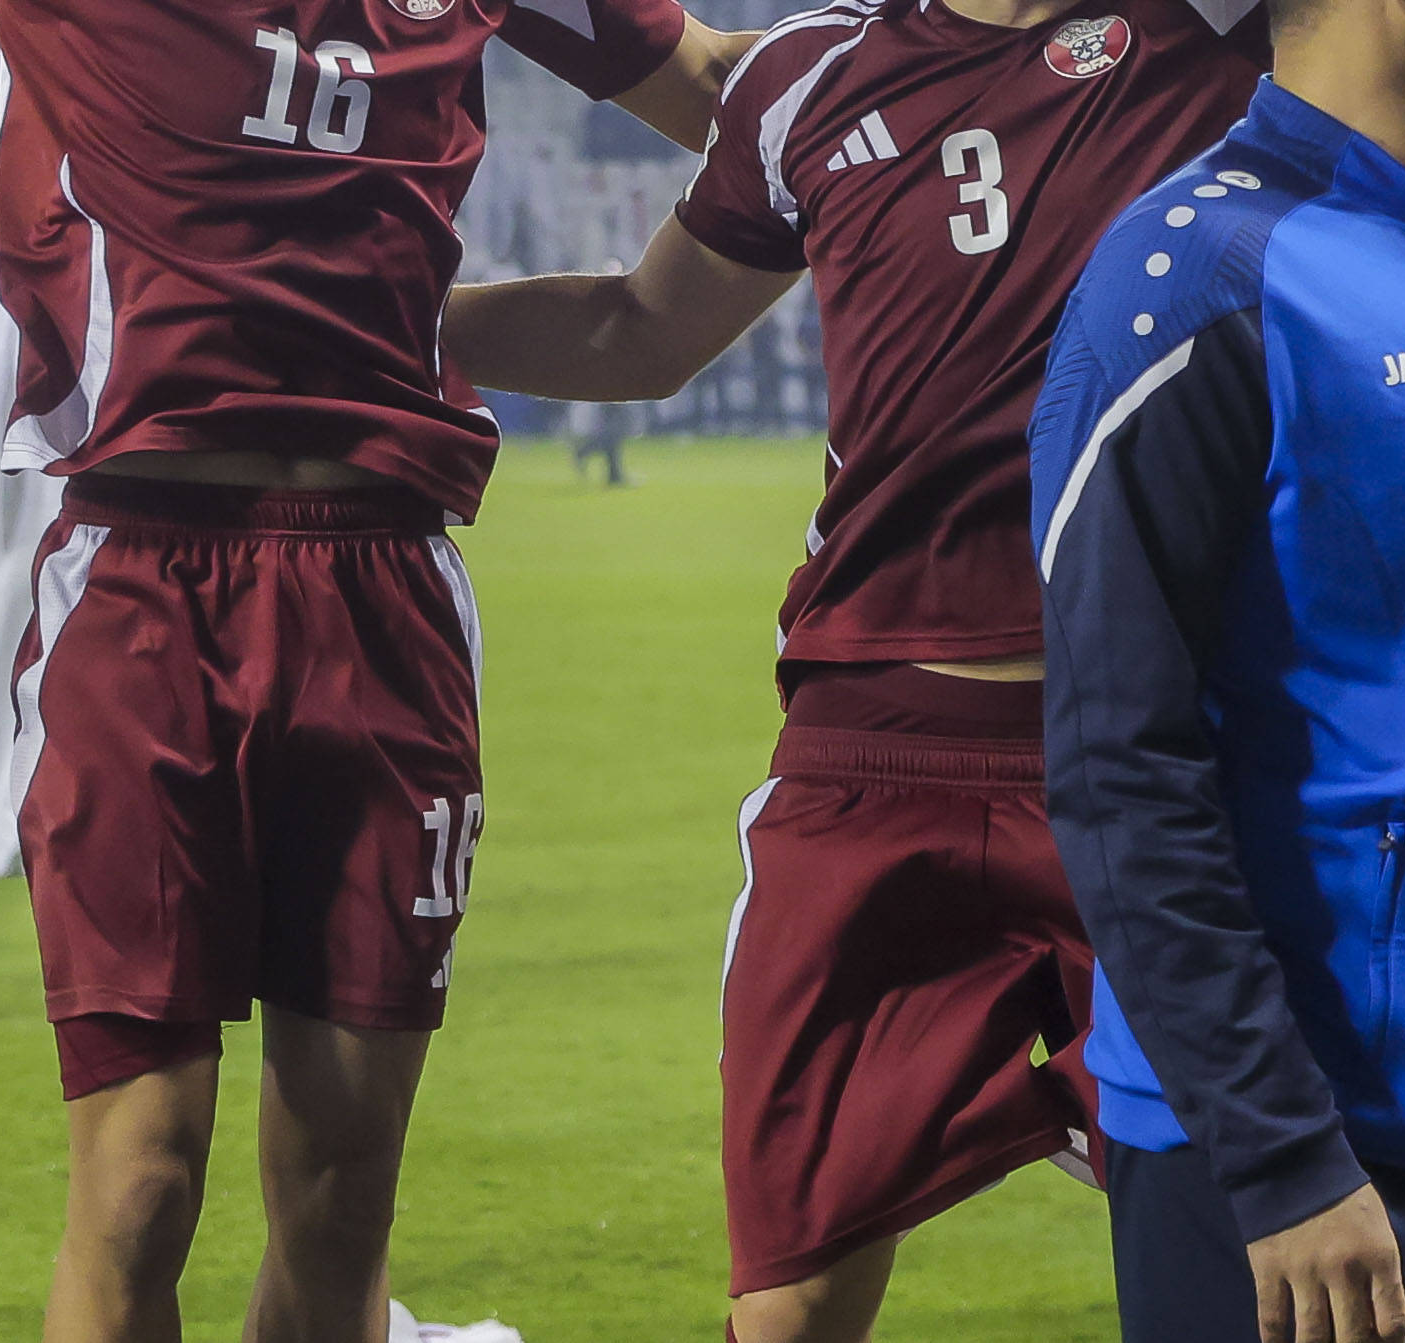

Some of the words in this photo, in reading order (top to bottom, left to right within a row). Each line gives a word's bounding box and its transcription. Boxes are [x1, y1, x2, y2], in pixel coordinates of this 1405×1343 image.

[241, 26, 375, 153] 16
[1075, 54, 1114, 75] QFA
[941, 128, 1009, 255] 3
[413, 792, 482, 917] 16
